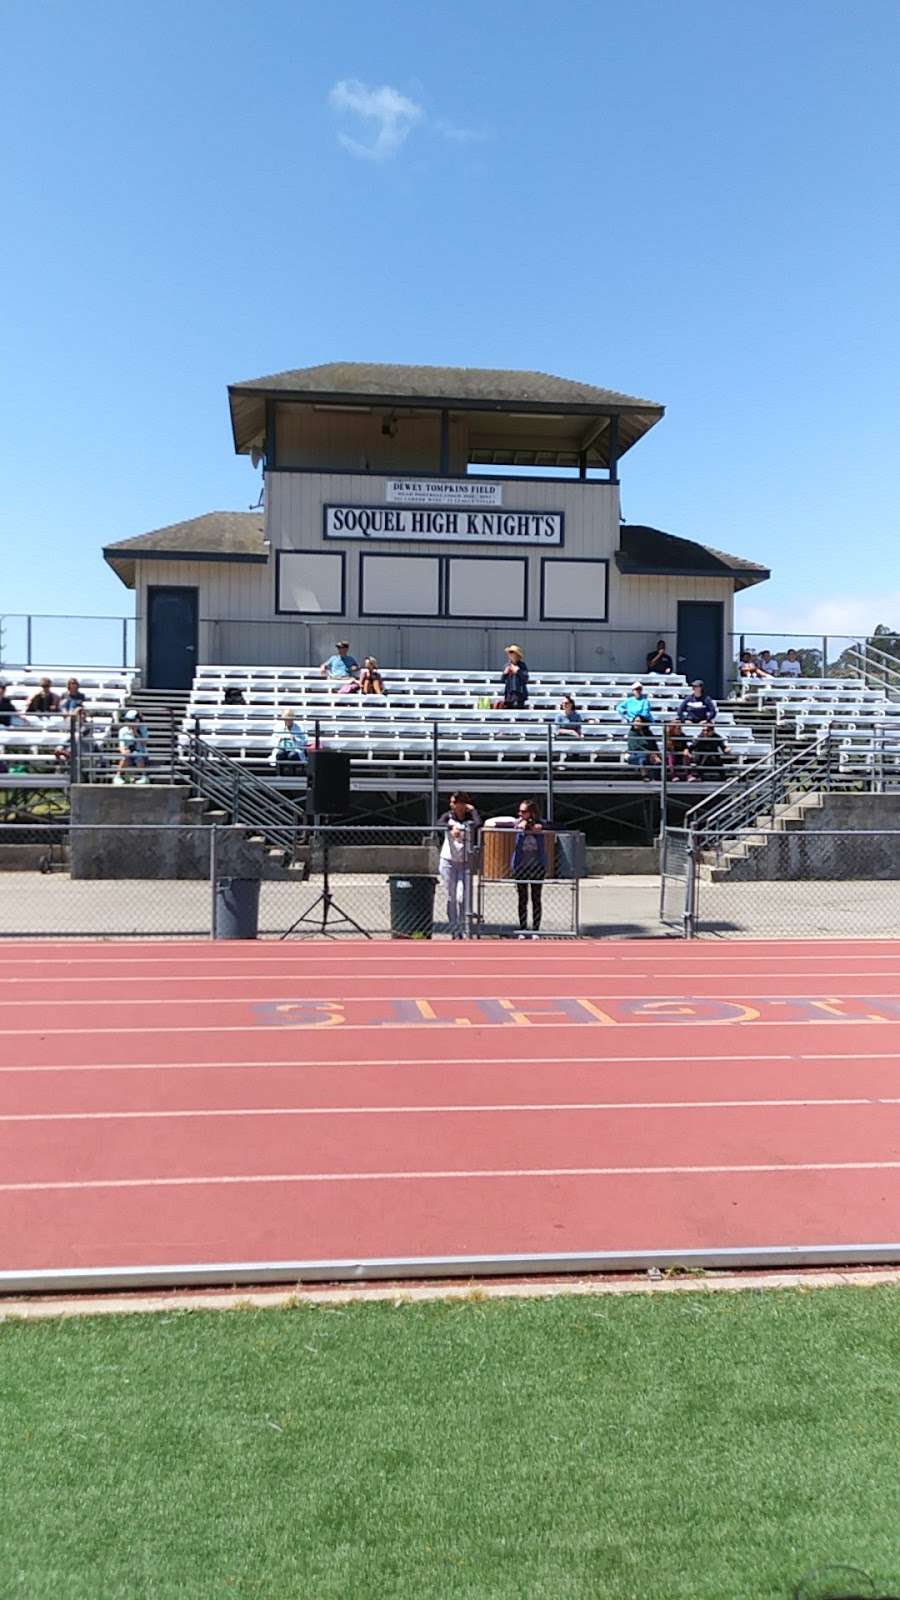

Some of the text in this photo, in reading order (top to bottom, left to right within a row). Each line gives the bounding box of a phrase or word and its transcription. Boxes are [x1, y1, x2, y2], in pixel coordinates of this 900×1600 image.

[393, 482, 496, 494] DEWEY TOMPKINS FIELD
[333, 509, 555, 537] SOQUEL HIGH KNIGHTS
